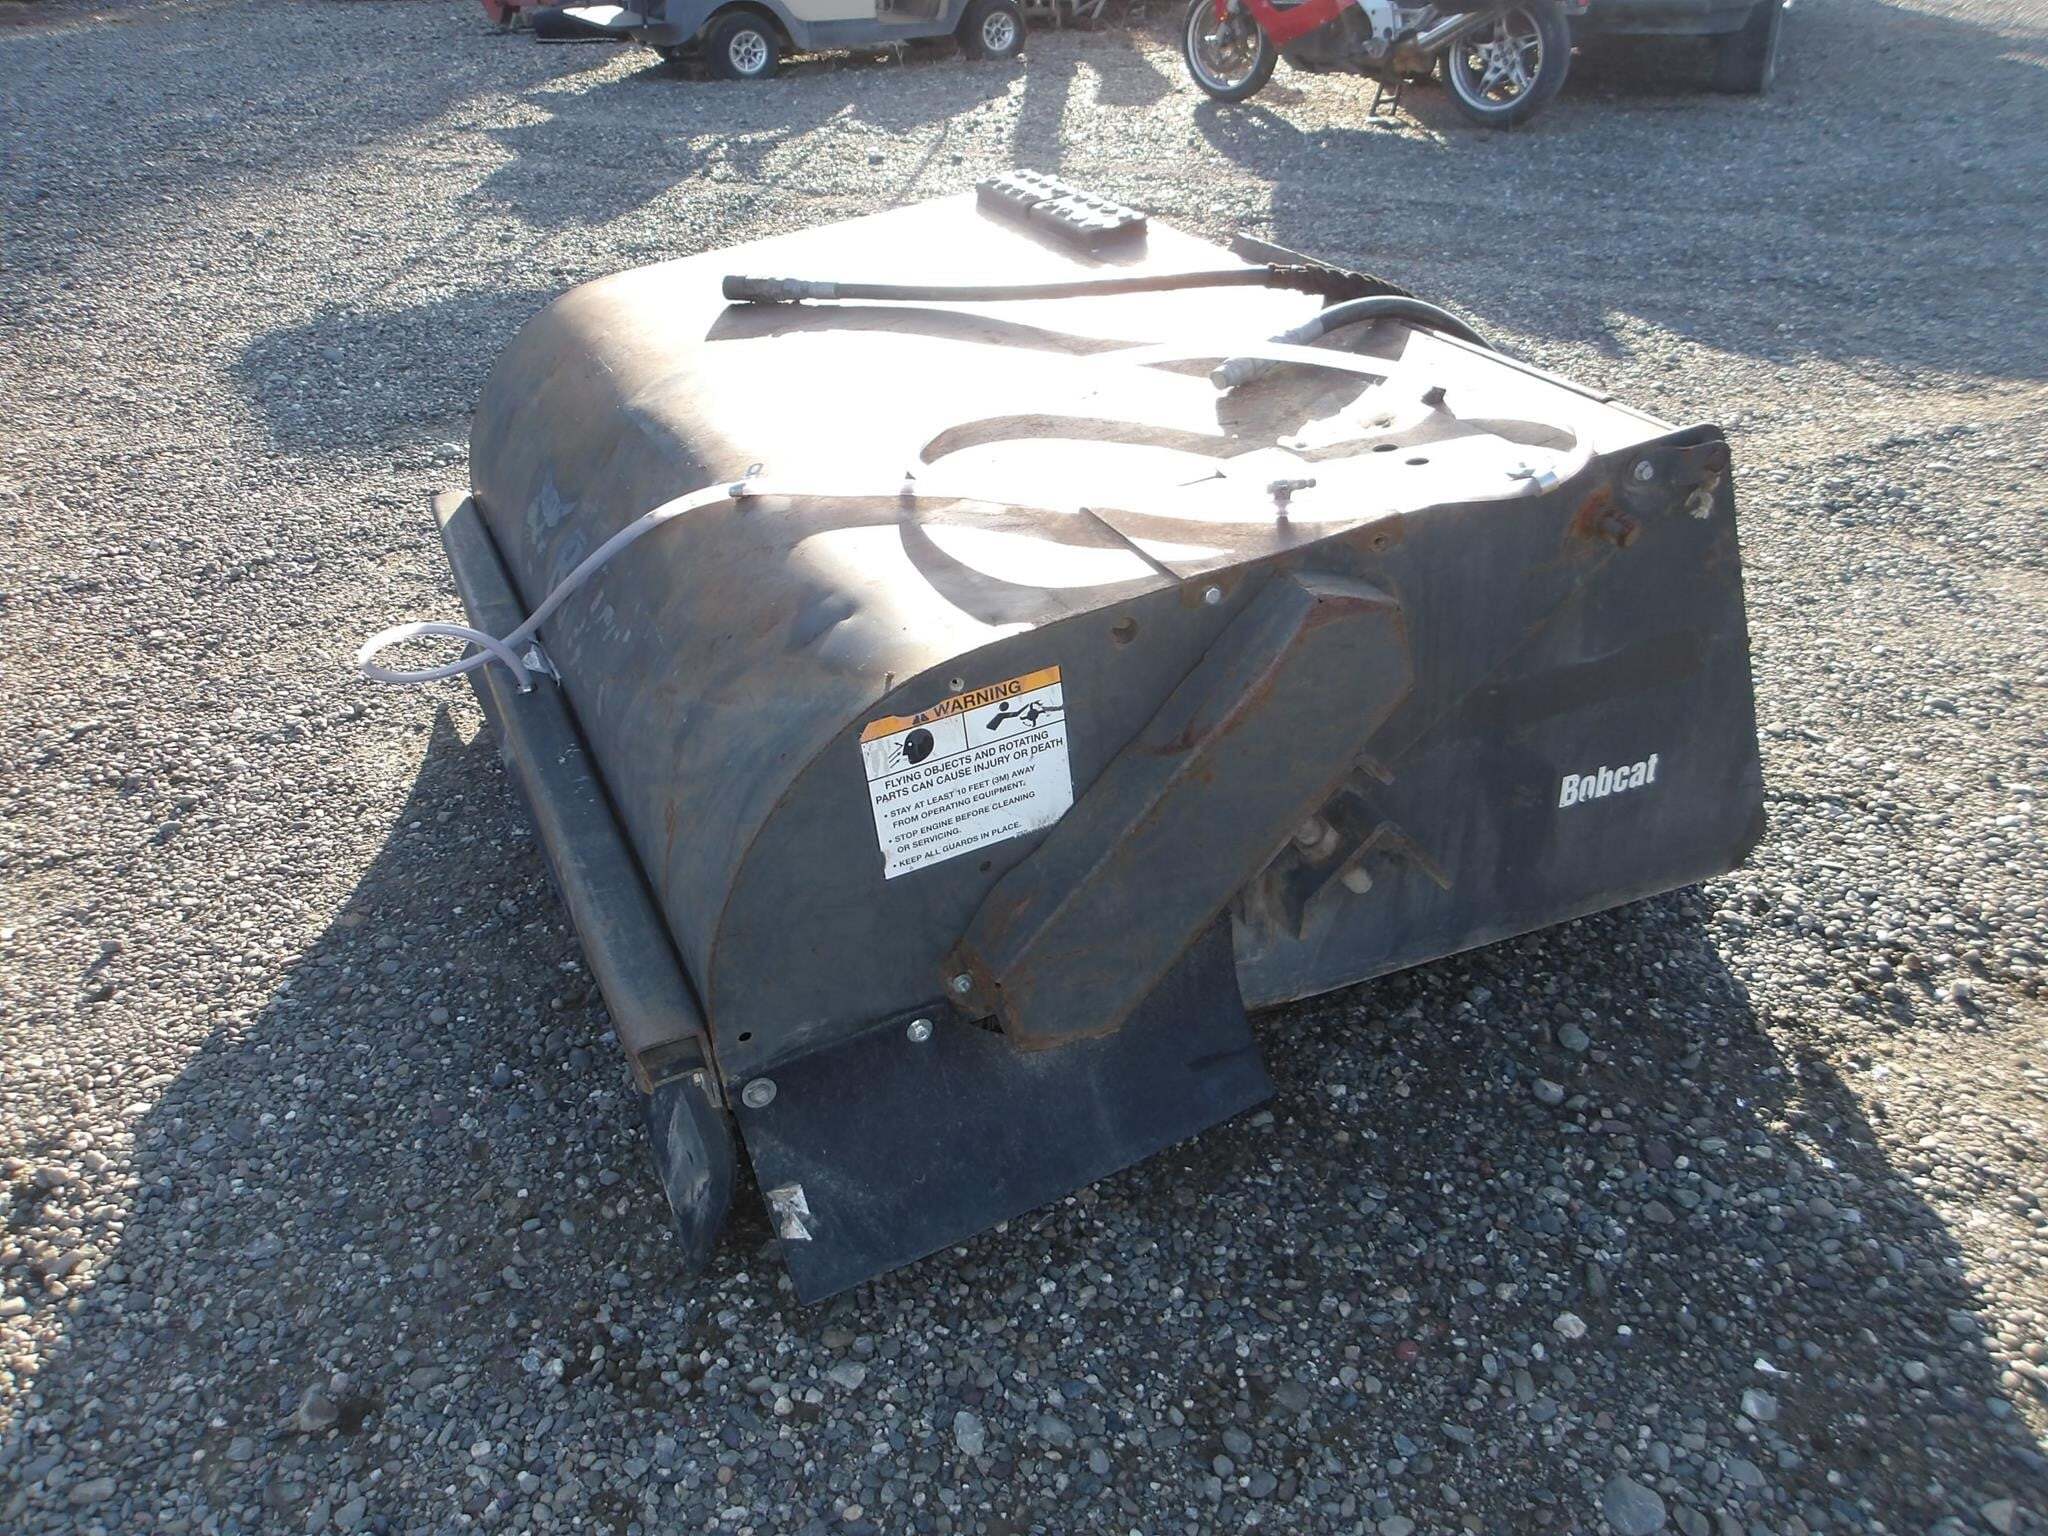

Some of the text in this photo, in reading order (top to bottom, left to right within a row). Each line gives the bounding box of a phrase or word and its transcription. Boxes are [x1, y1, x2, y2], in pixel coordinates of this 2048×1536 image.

[934, 680, 1021, 717] WARNING
[875, 737, 1063, 805] PARTS CAN CAUSE INJURY OR DEATH
[885, 730, 1049, 790] FLYING OBJECTS AND ROTATING
[1559, 753, 1659, 808] Bobcat
[890, 764, 1036, 818] STAY AT LEAST 10 FEET (3M) AWAY
[893, 814, 919, 829] FROM
[921, 797, 971, 819] OPERATING
[894, 790, 1036, 843] STOP ENGINE BEFORE CLEANING
[897, 844, 911, 854] OR
[899, 854, 922, 868] KEEP
[924, 848, 941, 859] ALL
[942, 835, 979, 853] GUARDS
[980, 831, 990, 840] IN
